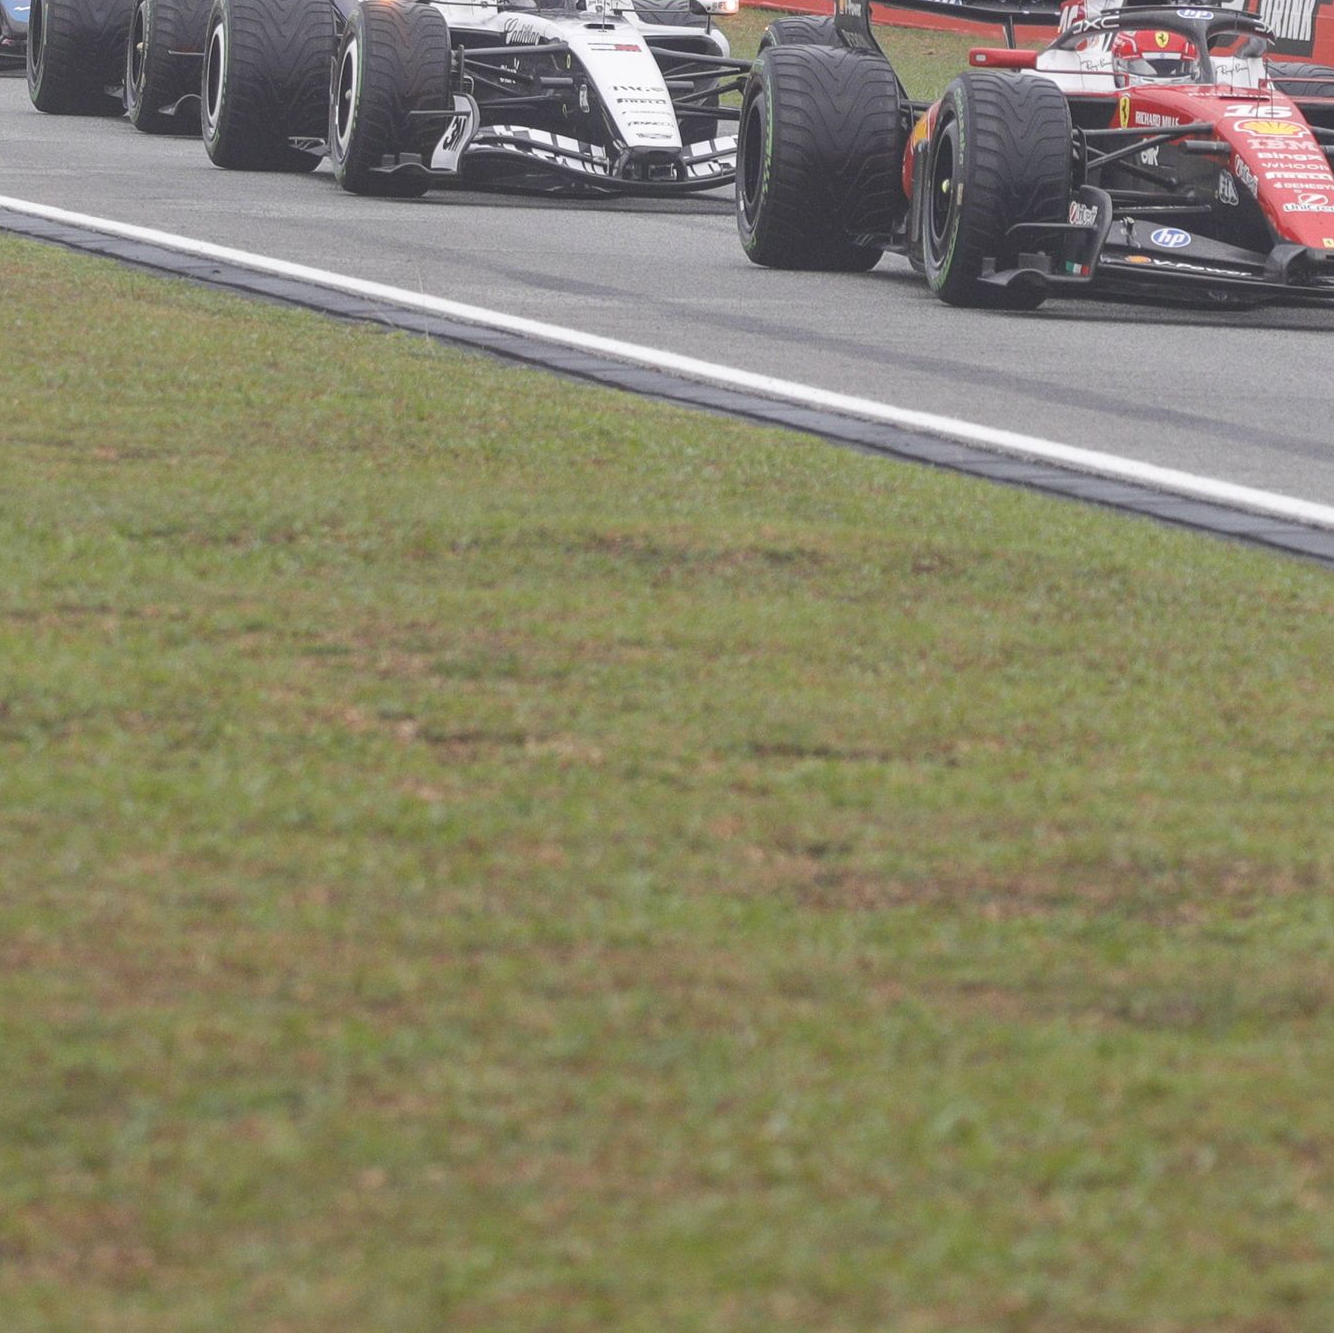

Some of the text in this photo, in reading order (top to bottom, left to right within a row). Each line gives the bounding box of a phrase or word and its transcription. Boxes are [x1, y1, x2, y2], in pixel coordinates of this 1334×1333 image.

[1135, 110, 1161, 126] RICHARD
[1223, 105, 1293, 119] 16
[1247, 139, 1319, 153] IBM
[1257, 152, 1324, 162] BingX
[1155, 227, 1188, 247] hp
